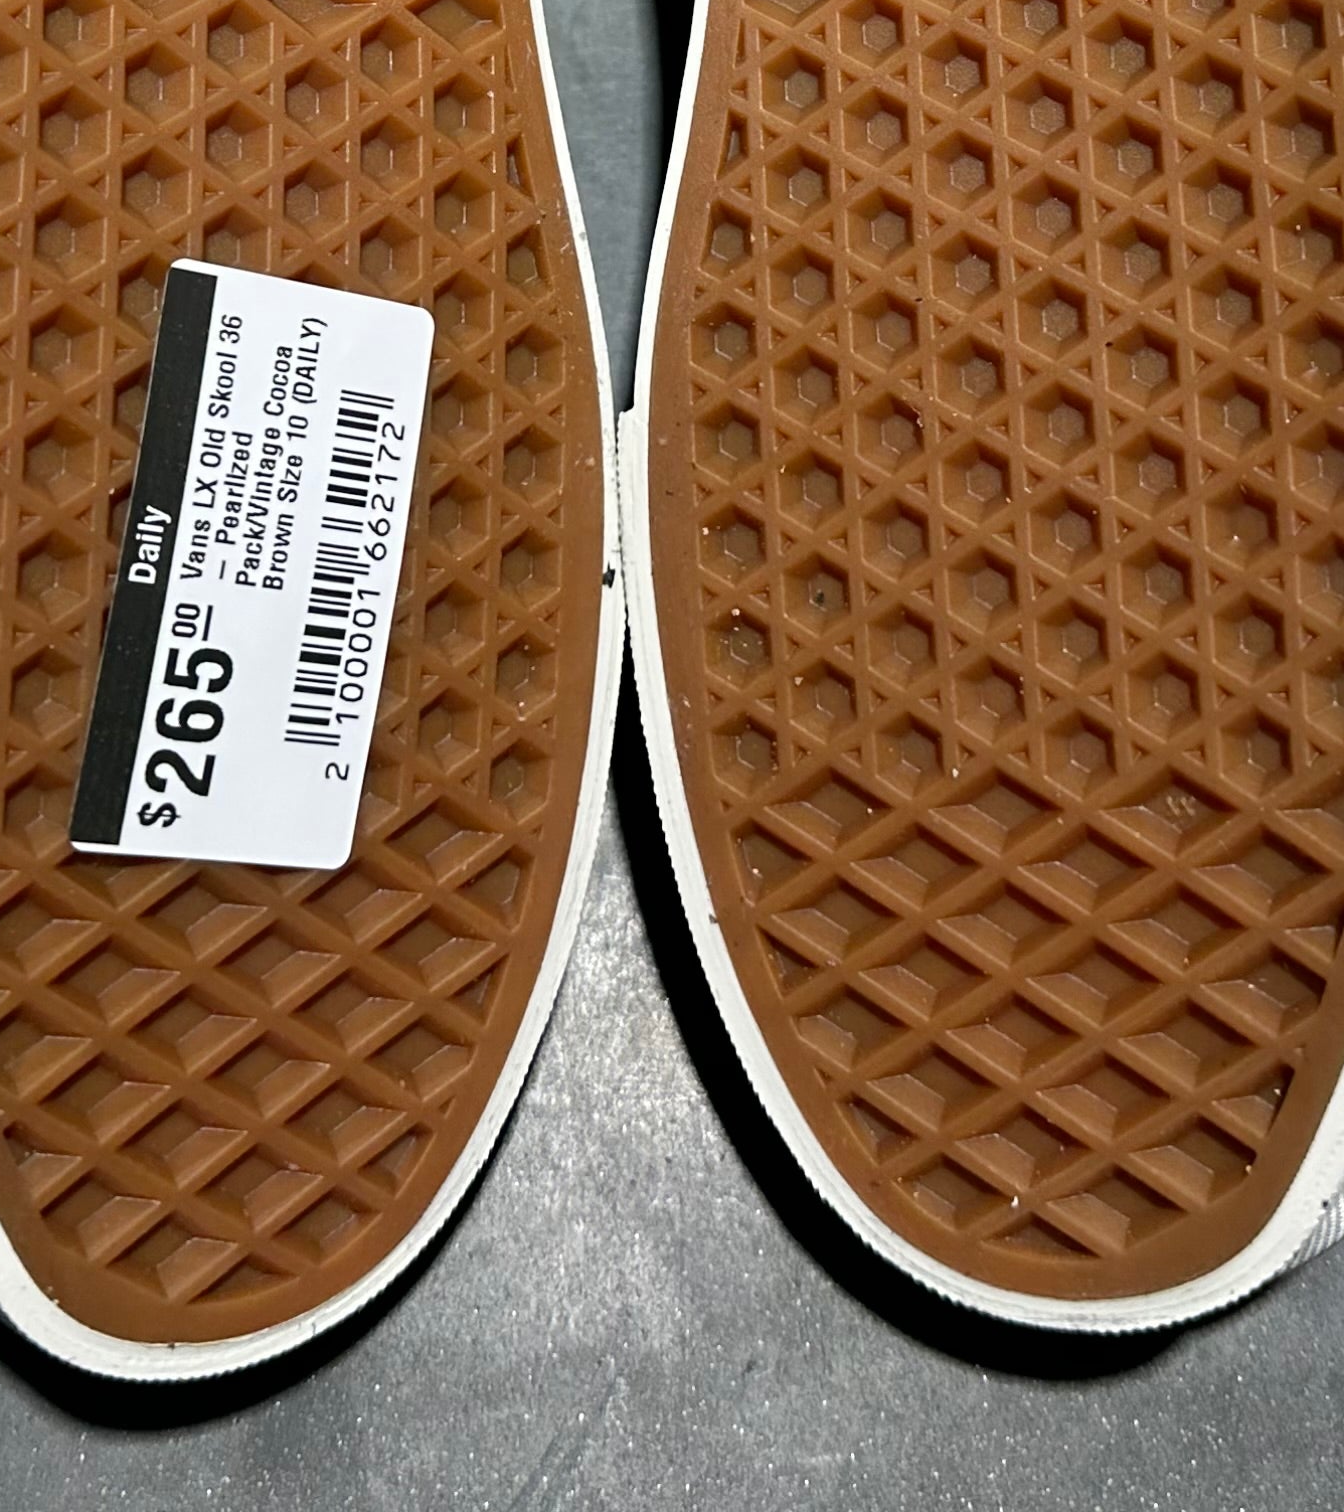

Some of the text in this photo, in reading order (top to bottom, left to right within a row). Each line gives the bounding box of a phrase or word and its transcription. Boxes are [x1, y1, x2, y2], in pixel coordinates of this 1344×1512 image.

[126, 503, 173, 586] Daily
[178, 313, 244, 581] Vans LX Old Skool 36
[213, 430, 254, 546] Pearlized
[233, 345, 302, 588] Pack/Vintage Cocoa
[260, 316, 329, 592] Brown Size 10 (DAILY)
[323, 421, 406, 782] 2 100001 662172
[136, 646, 235, 829] $265
